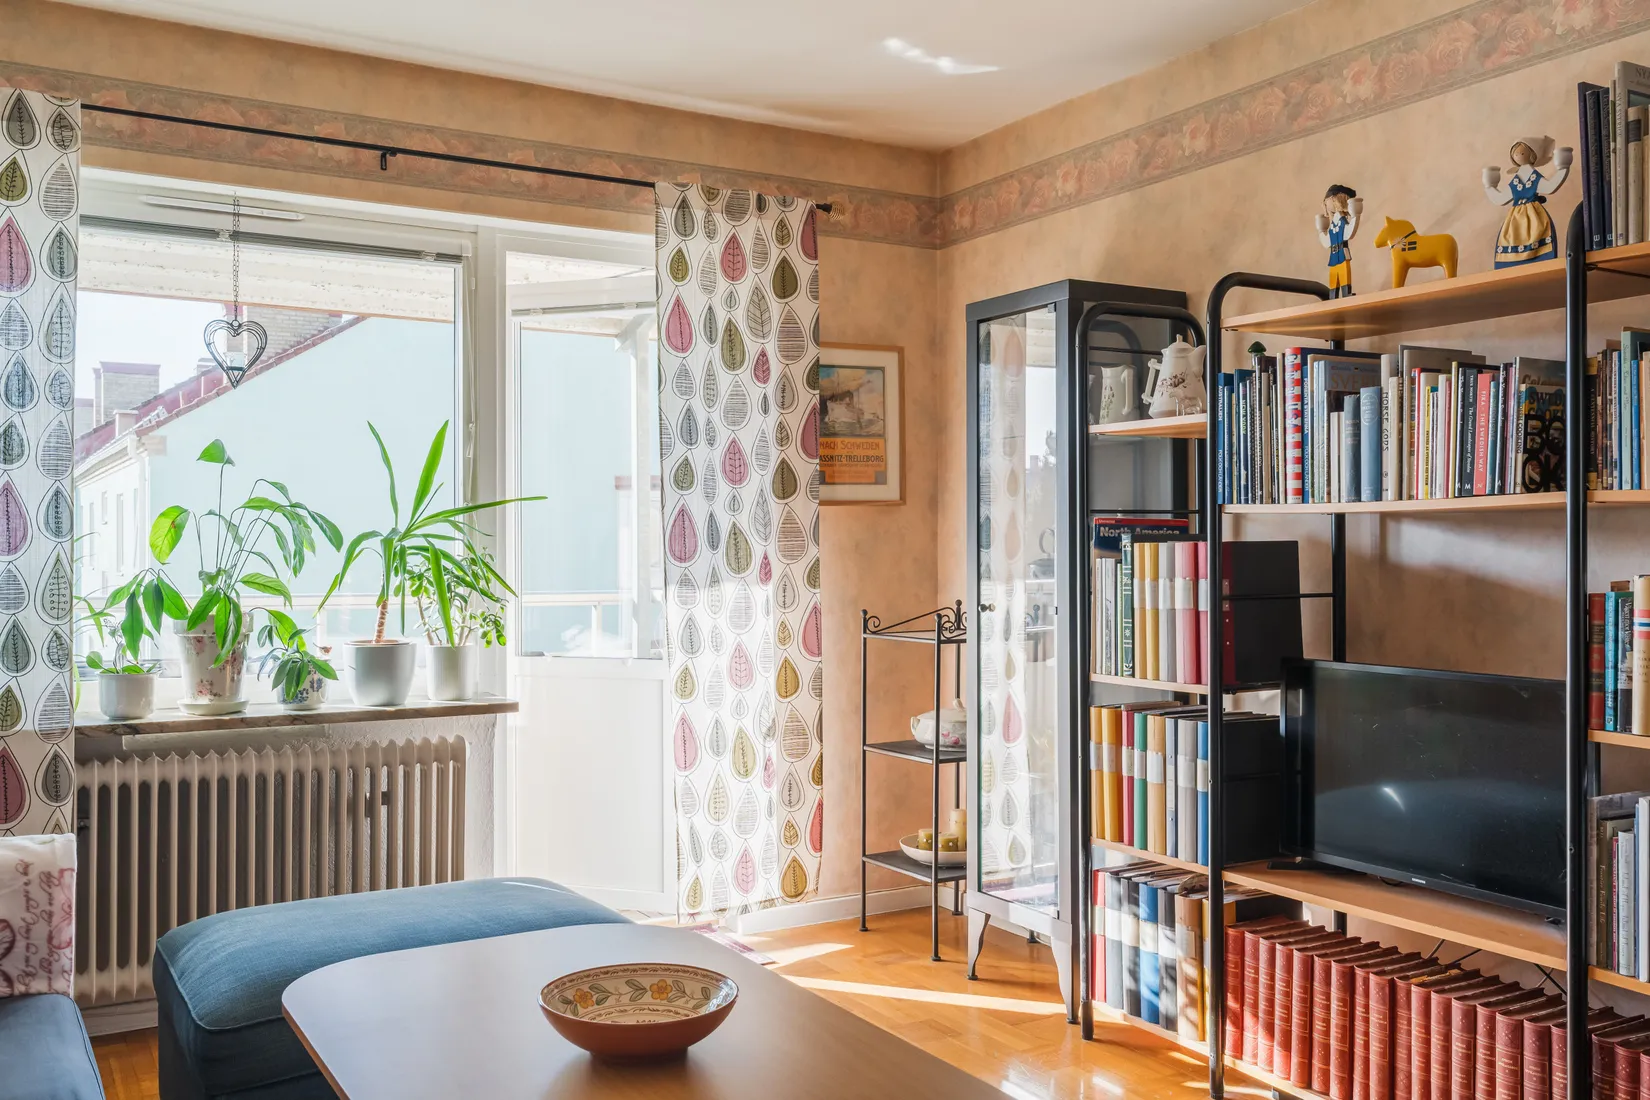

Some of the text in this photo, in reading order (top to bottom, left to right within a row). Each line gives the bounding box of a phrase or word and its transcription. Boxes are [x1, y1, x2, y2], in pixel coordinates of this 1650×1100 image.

[1635, 67, 1650, 79] NY
[1528, 391, 1565, 405] SWED
[820, 440, 880, 450] NACH SCHWEDEN
[1099, 526, 1180, 537] North America
